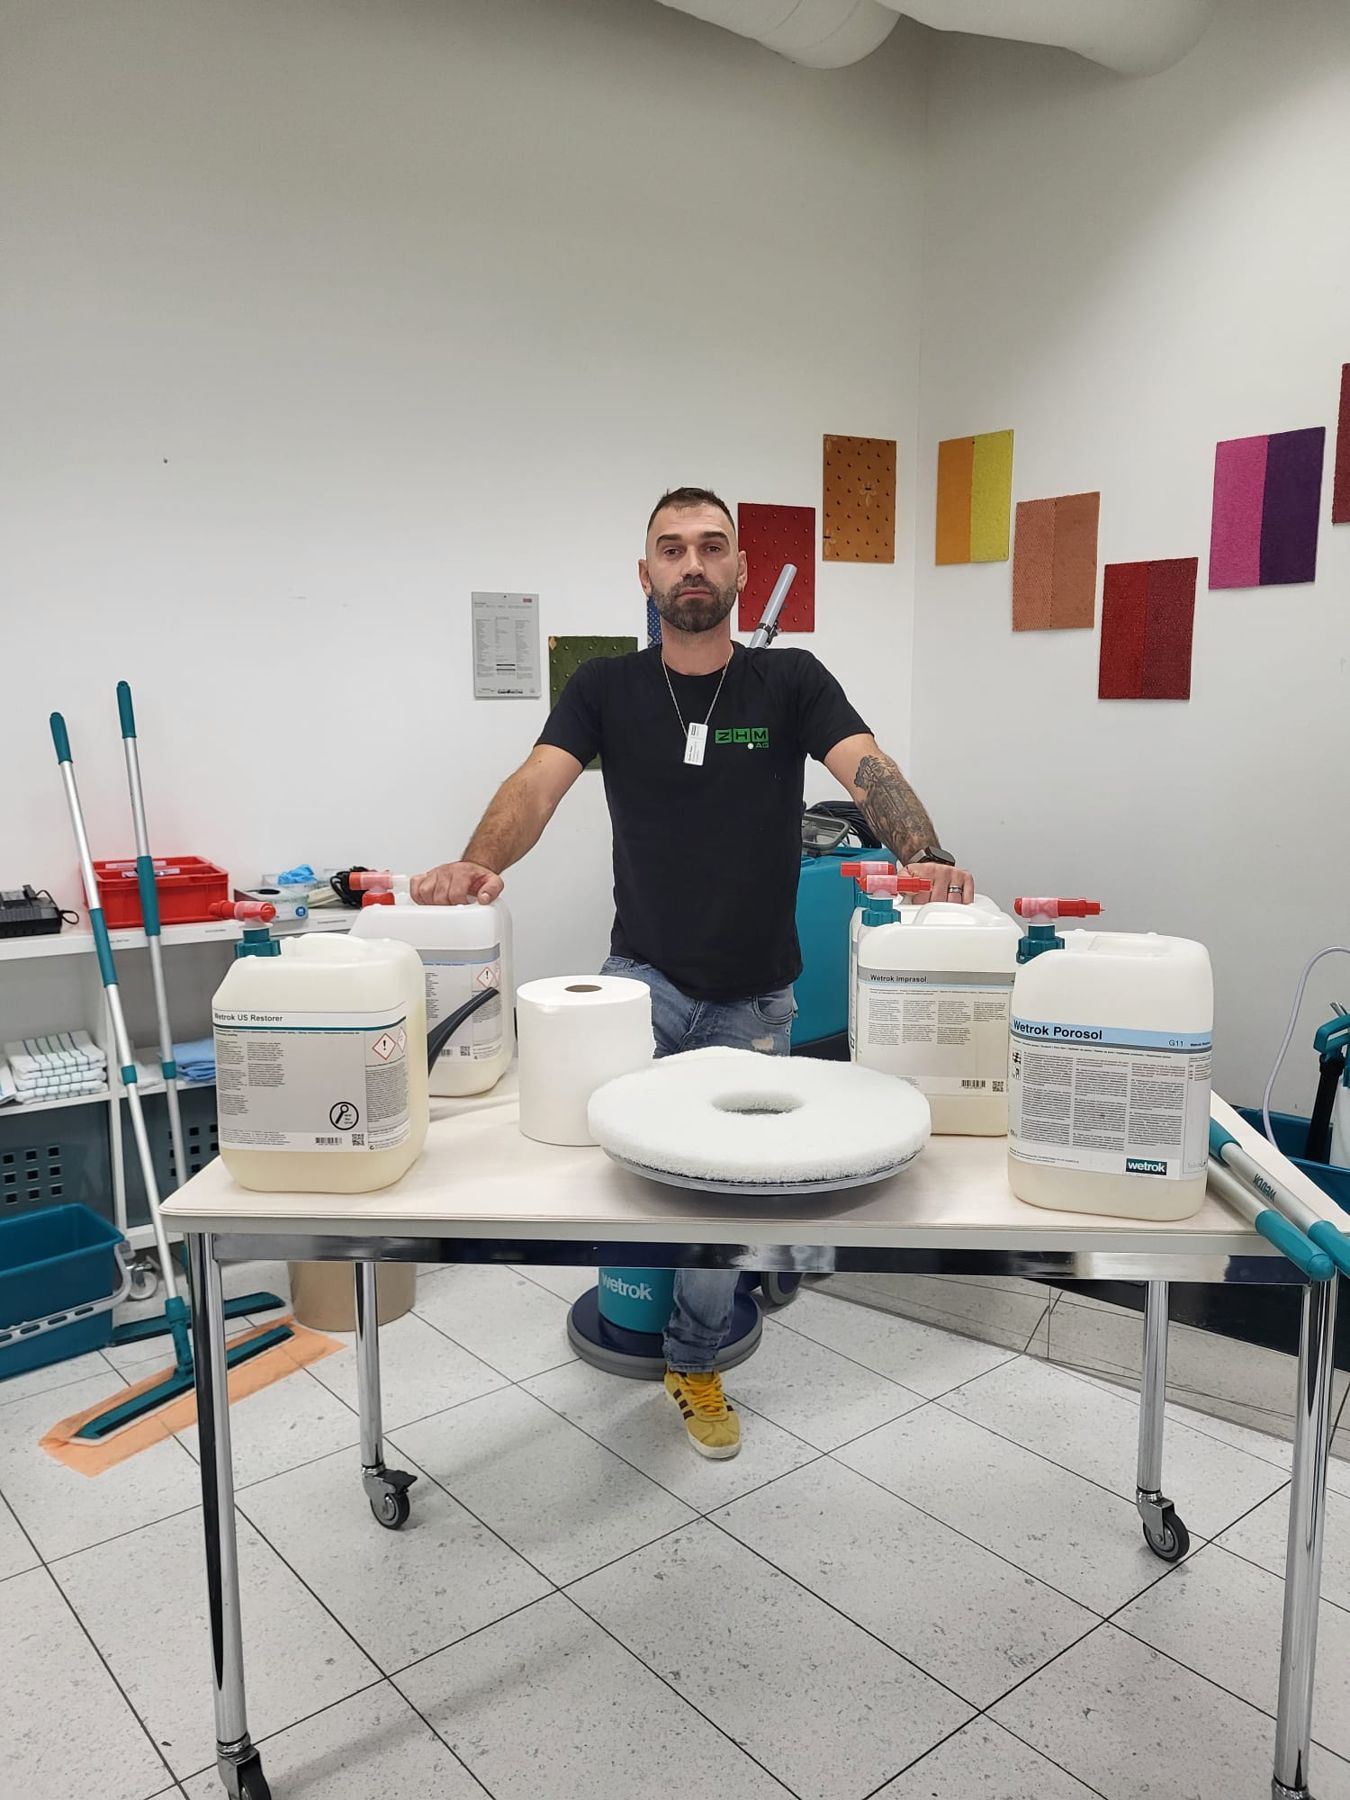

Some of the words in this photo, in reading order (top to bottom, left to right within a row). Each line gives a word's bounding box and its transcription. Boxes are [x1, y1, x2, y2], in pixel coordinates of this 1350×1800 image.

[715, 728, 768, 743] ZHM
[869, 974, 895, 983] Wetrok
[250, 1014, 284, 1022] Restorer
[1013, 1019, 1049, 1036] Wetrok
[1053, 1026, 1103, 1041] Porosol
[1168, 1039, 1184, 1047] G11
[1127, 1160, 1166, 1174] wetrok
[600, 1271, 653, 1301] wetrok
